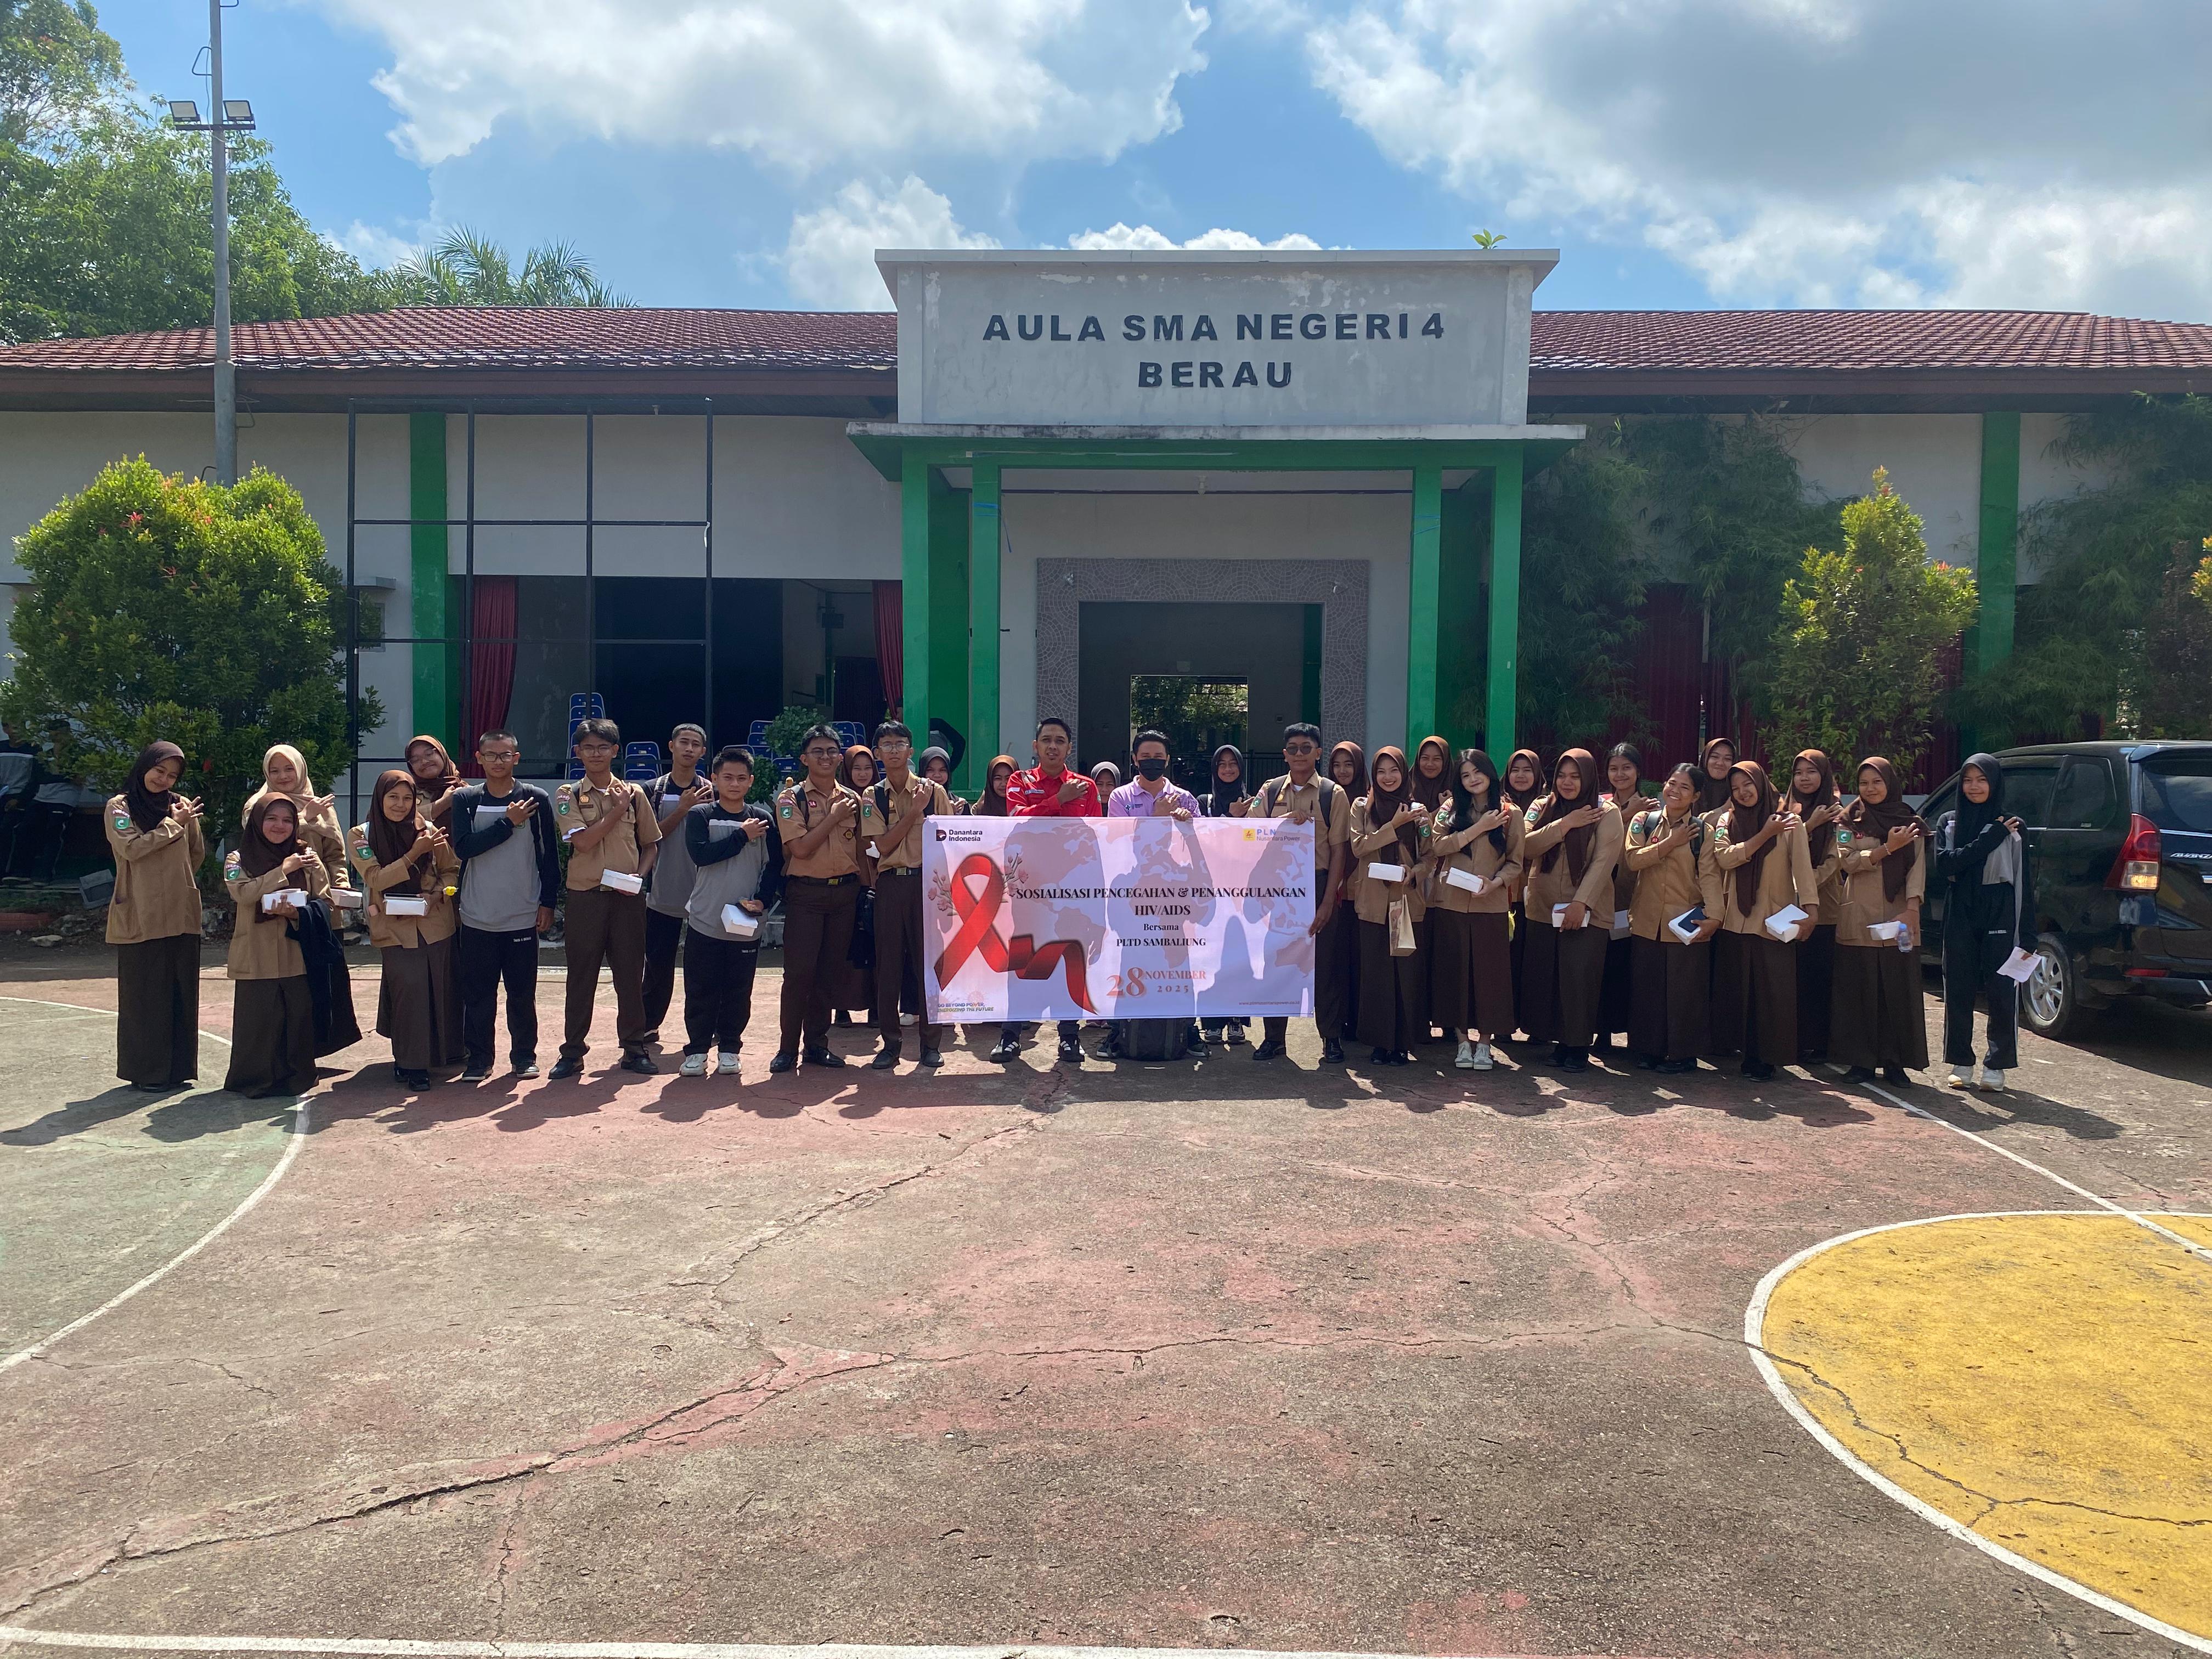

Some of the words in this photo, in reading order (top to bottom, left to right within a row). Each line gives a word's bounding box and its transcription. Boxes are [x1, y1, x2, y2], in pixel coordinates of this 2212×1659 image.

[983, 314, 1105, 341] AULA
[1122, 314, 1218, 341] SMA
[1237, 313, 1408, 341] NEGERI
[1422, 313, 1444, 339] 4
[1138, 362, 1291, 388] BERAU
[1016, 888, 1090, 899] SOSIALISASI
[1094, 887, 1175, 899] PENCEGAHAN
[1178, 887, 1189, 898] &
[1191, 887, 1306, 898] PENANGGULANGAN
[1135, 905, 1190, 916] HIV/AIDS
[1143, 923, 1179, 932] Bersama
[1116, 938, 1141, 947] PLTD
[1143, 938, 1206, 947] SAMBALIUNG
[1106, 967, 1145, 997] 28
[1145, 970, 1206, 980] NOVEMBER
